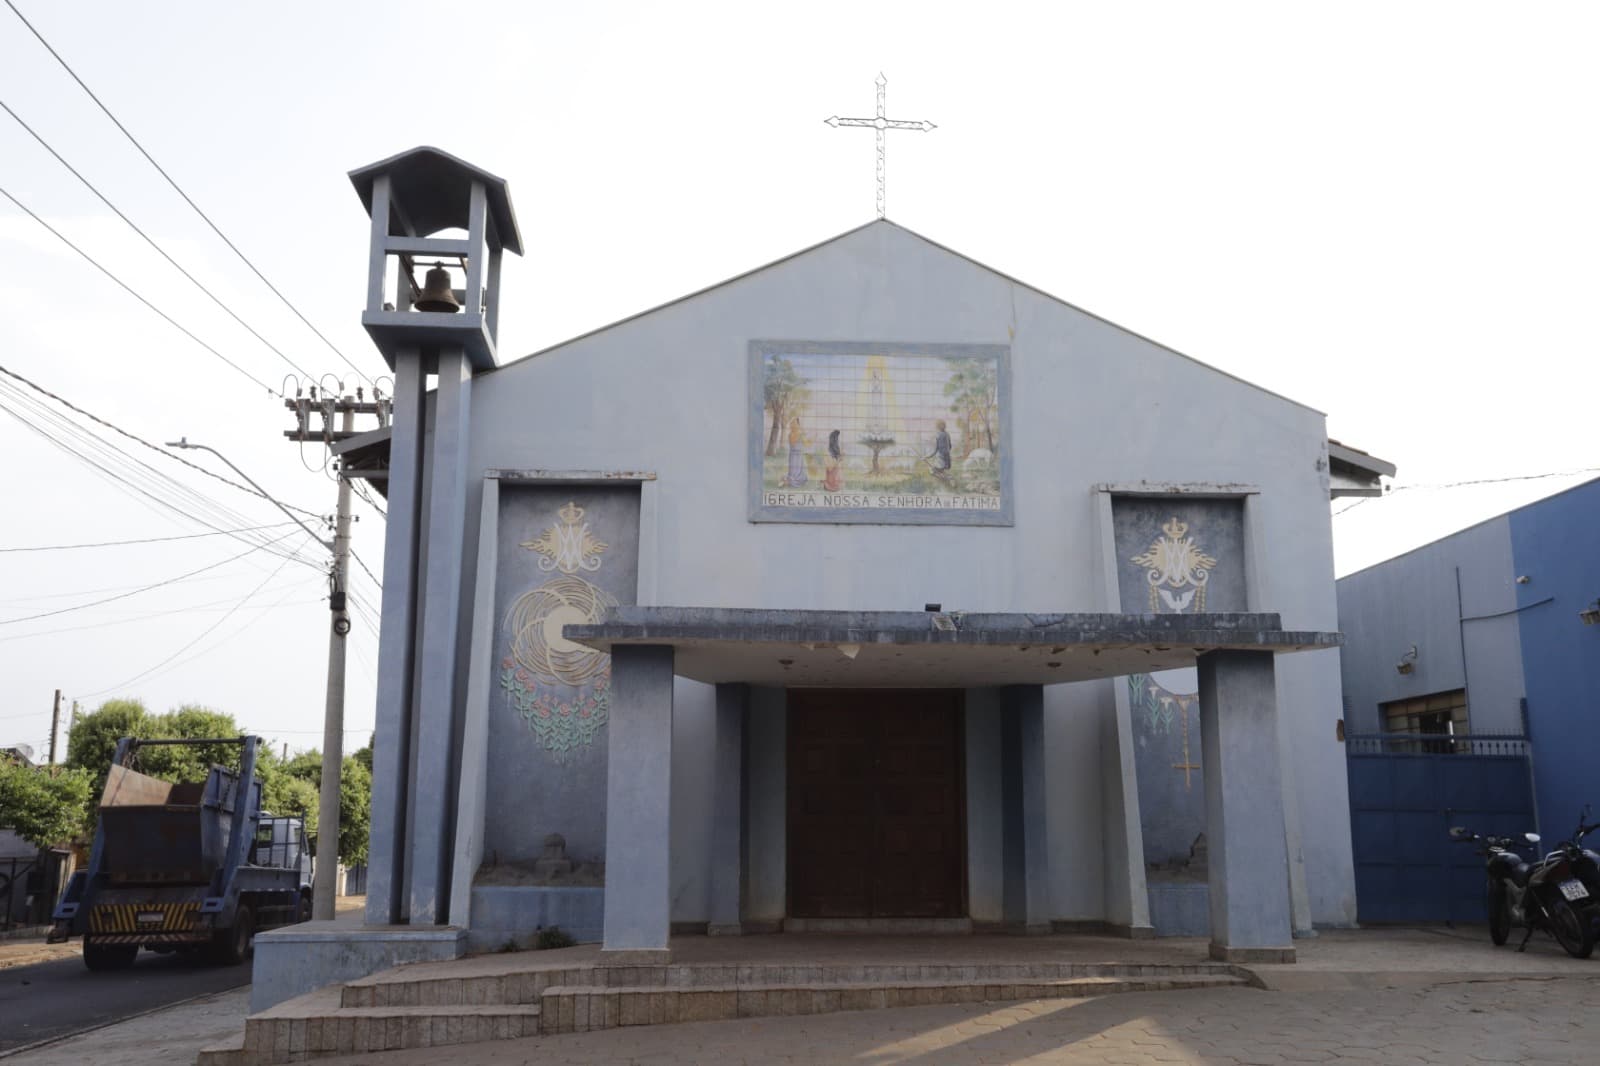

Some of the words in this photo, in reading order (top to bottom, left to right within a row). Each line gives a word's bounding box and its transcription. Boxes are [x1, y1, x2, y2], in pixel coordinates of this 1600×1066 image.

[763, 493, 816, 506] IGREJA
[823, 495, 870, 507] NOSSA
[878, 496, 942, 508] SENHORA
[952, 496, 998, 508] FATIMA
